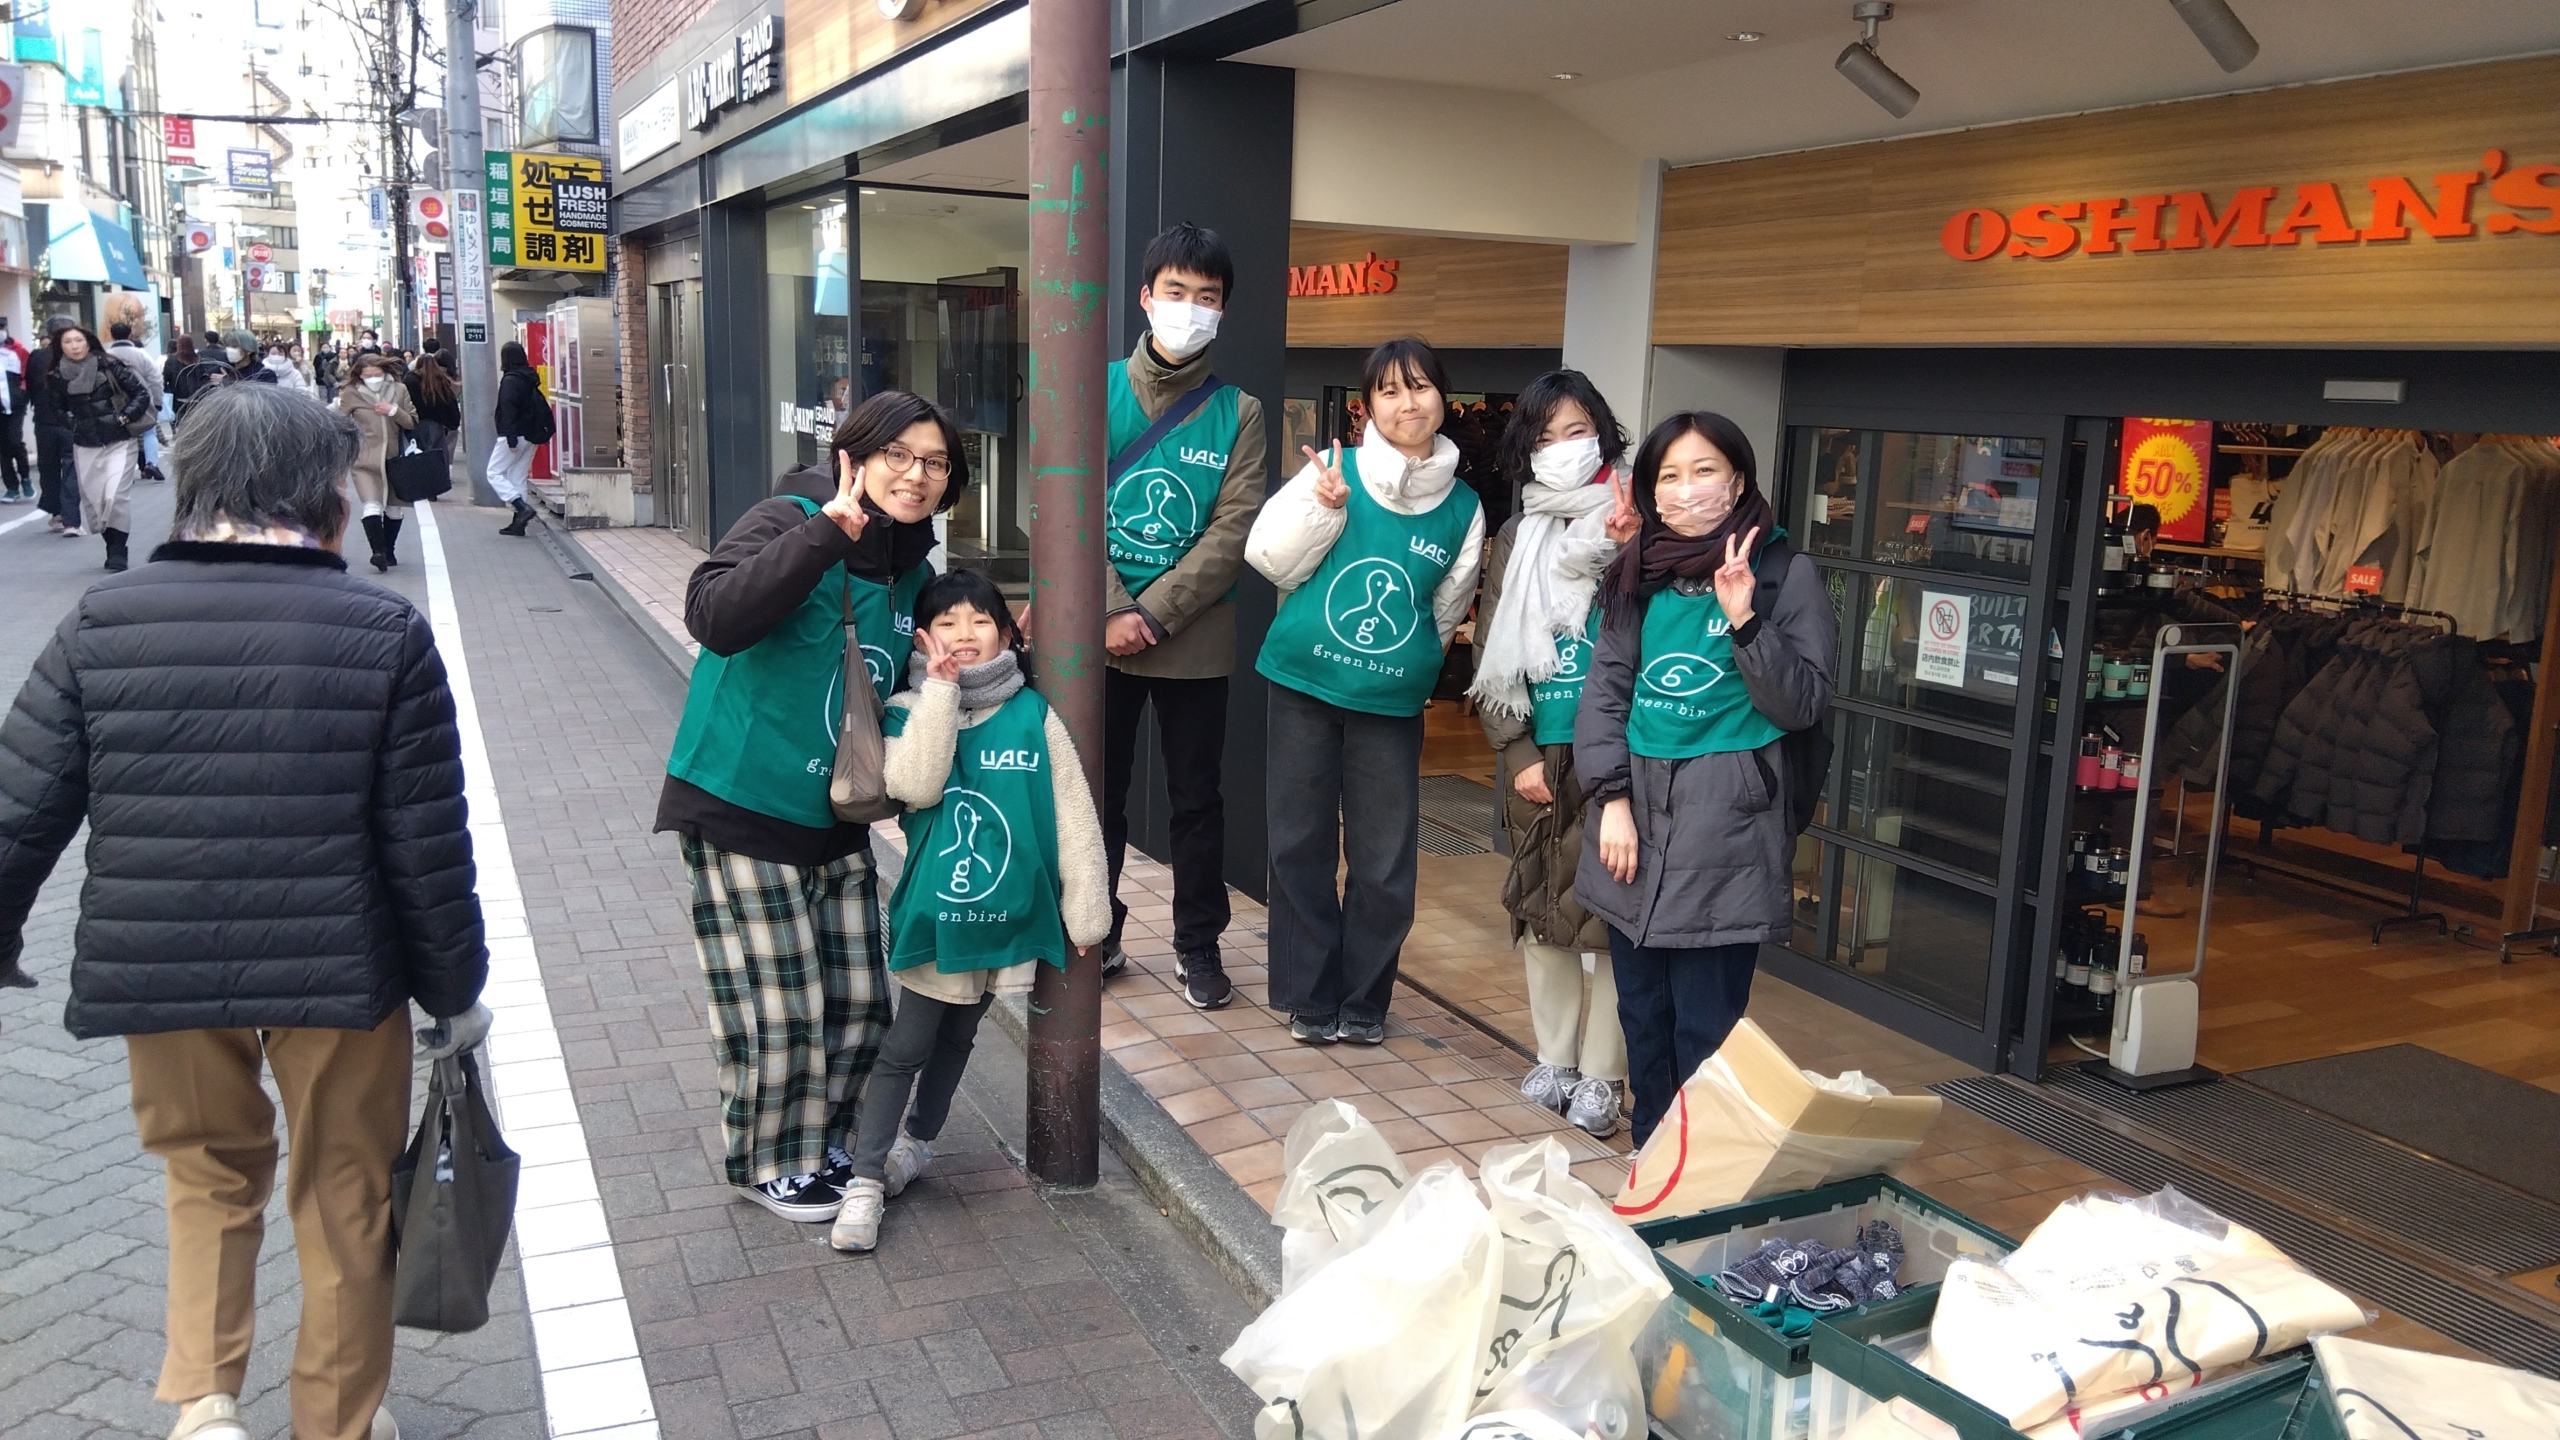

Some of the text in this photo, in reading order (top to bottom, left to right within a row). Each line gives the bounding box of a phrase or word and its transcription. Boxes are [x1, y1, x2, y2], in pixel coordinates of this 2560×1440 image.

[741, 14, 773, 67] GRAND
[687, 47, 736, 131] ABC-MART
[741, 53, 771, 103] STAGE
[558, 184, 607, 202] LUSH
[1940, 149, 2560, 261] OSHMAN'S
[489, 161, 512, 255] 稲垣薬局
[558, 199, 608, 214] FRESH
[559, 211, 608, 222] HANDMADE
[559, 219, 608, 230] COSMETICS
[524, 232, 594, 265] 調剤
[780, 401, 814, 434] ABC-MART
[815, 405, 835, 425] GRAND
[815, 424, 834, 443] STAGE
[1179, 446, 1229, 470] UACJ
[2133, 457, 2193, 500] 50%
[1910, 520, 1926, 528] SALE
[1109, 543, 1154, 564] green
[1408, 534, 1452, 569] UACJ
[1971, 533, 2033, 566] YETI
[2349, 572, 2377, 587] SALE
[893, 611, 914, 636] UA
[1312, 643, 1405, 678] green bird
[979, 749, 1040, 773] UACJ
[966, 909, 1009, 924] bird
